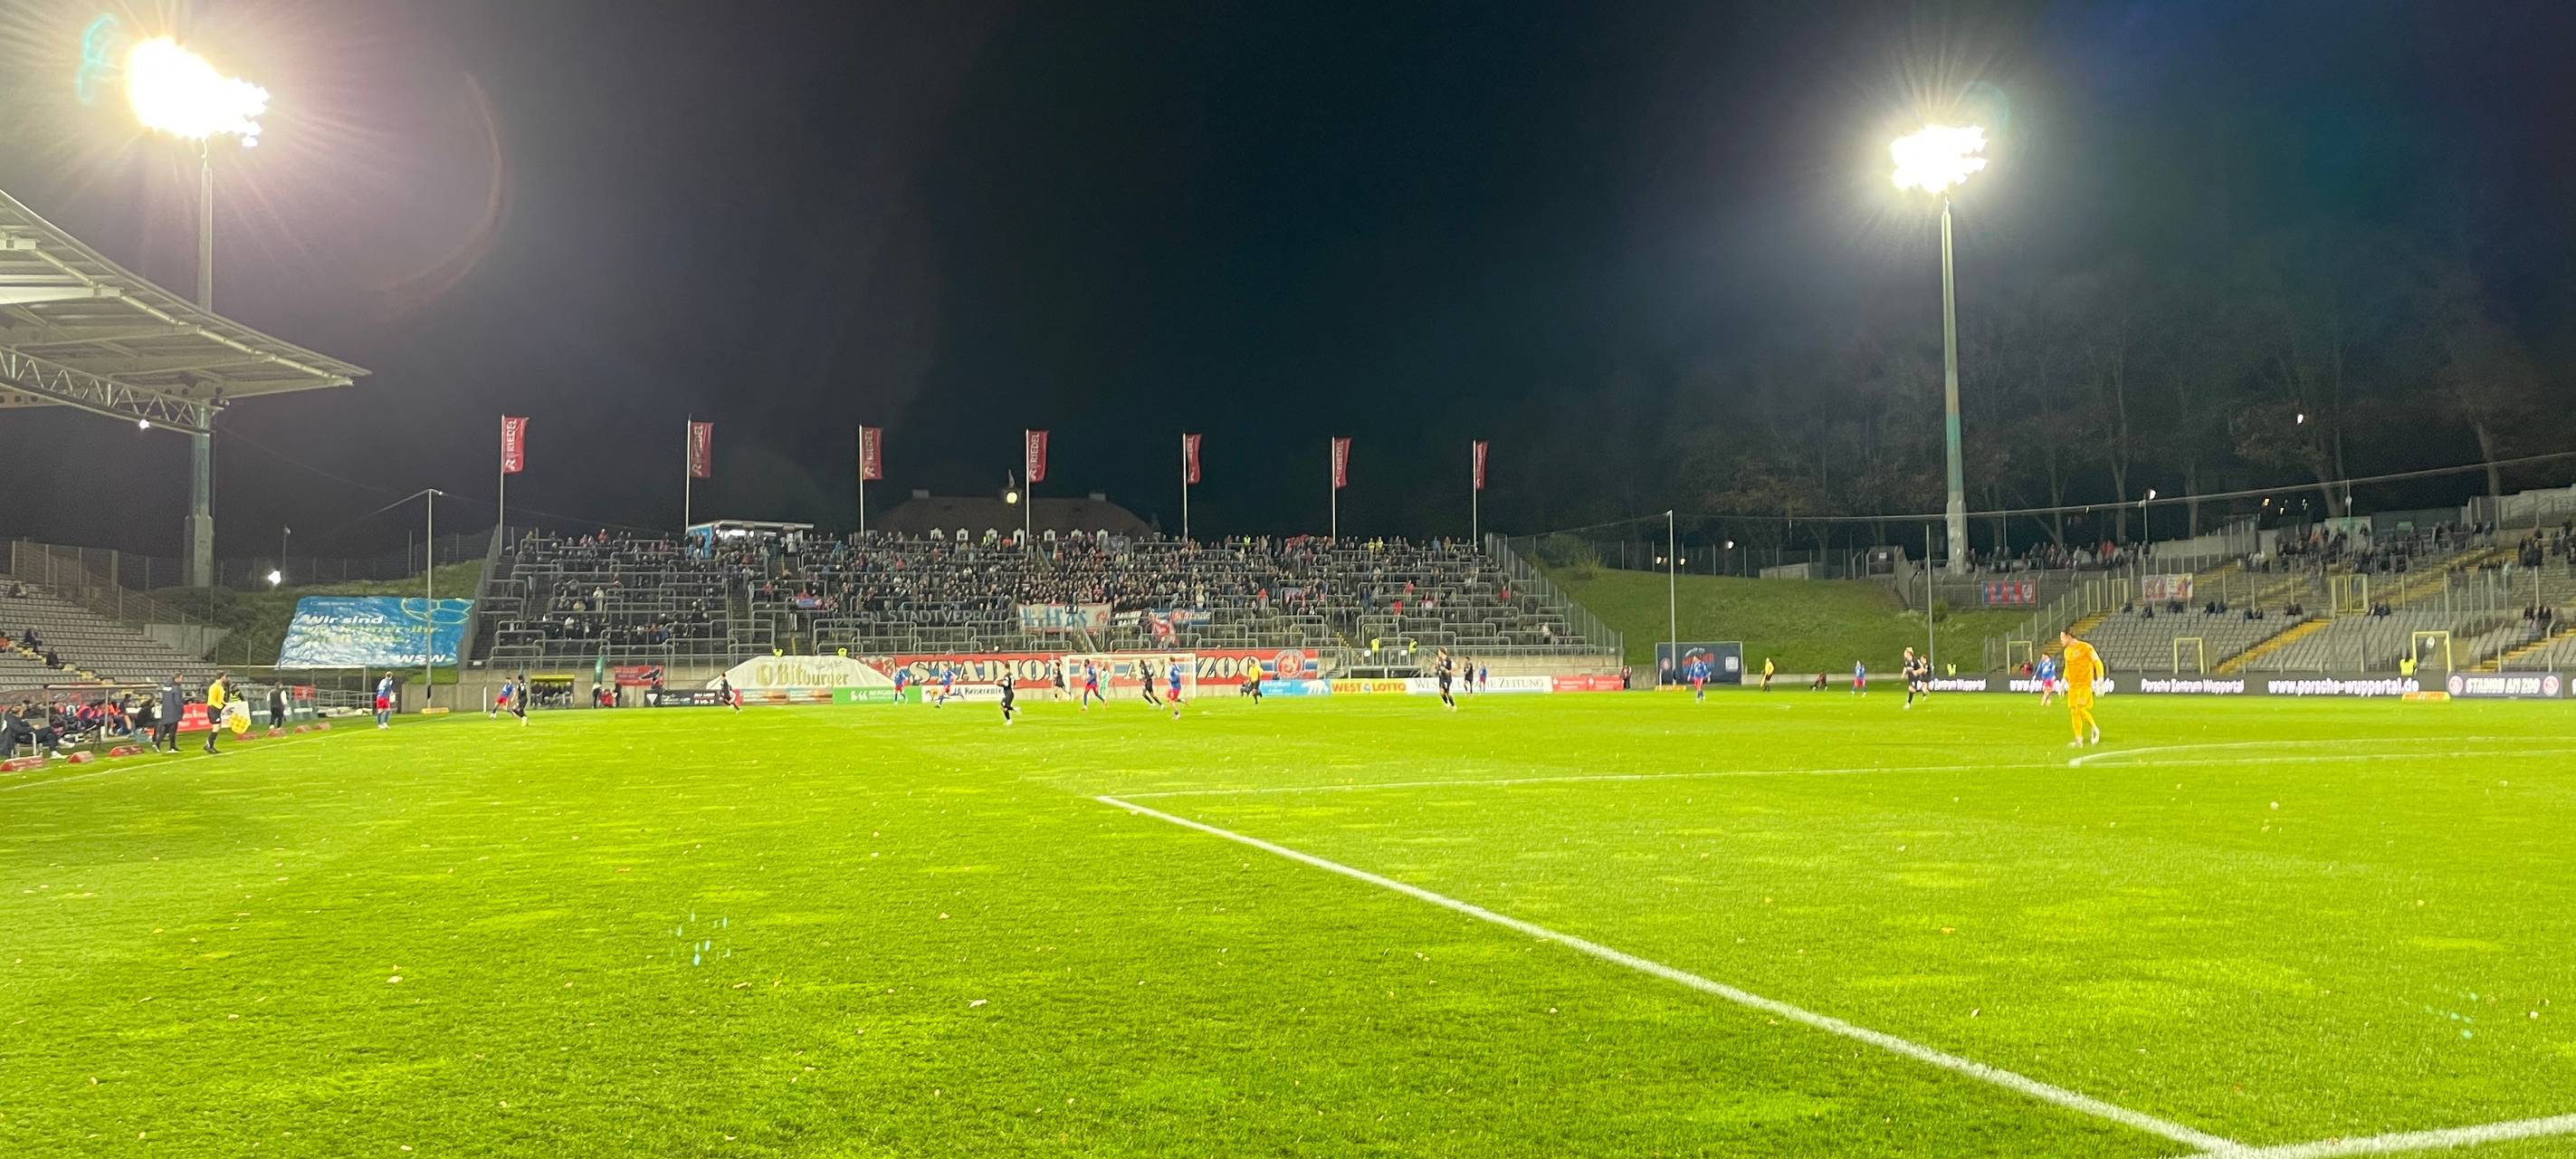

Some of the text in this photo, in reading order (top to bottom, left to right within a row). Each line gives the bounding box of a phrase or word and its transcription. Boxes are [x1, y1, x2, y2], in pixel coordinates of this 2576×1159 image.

[506, 419, 517, 452] RIEDEL
[1030, 433, 1040, 464] RIEDEL
[303, 615, 384, 624] Wir sind
[776, 663, 849, 687] Bitburger
[1196, 656, 1262, 680] ZOO
[965, 686, 1003, 695] Reisecente
[1332, 682, 1406, 692] WEST LOTTO
[1499, 677, 1544, 689] ZEITUNG
[2171, 678, 2202, 694] Zentrum
[2203, 678, 2245, 694] Wuppertal
[2268, 677, 2419, 697] www.porsche-wuppertal.de
[2466, 677, 2541, 694] STADION AM ZOO
